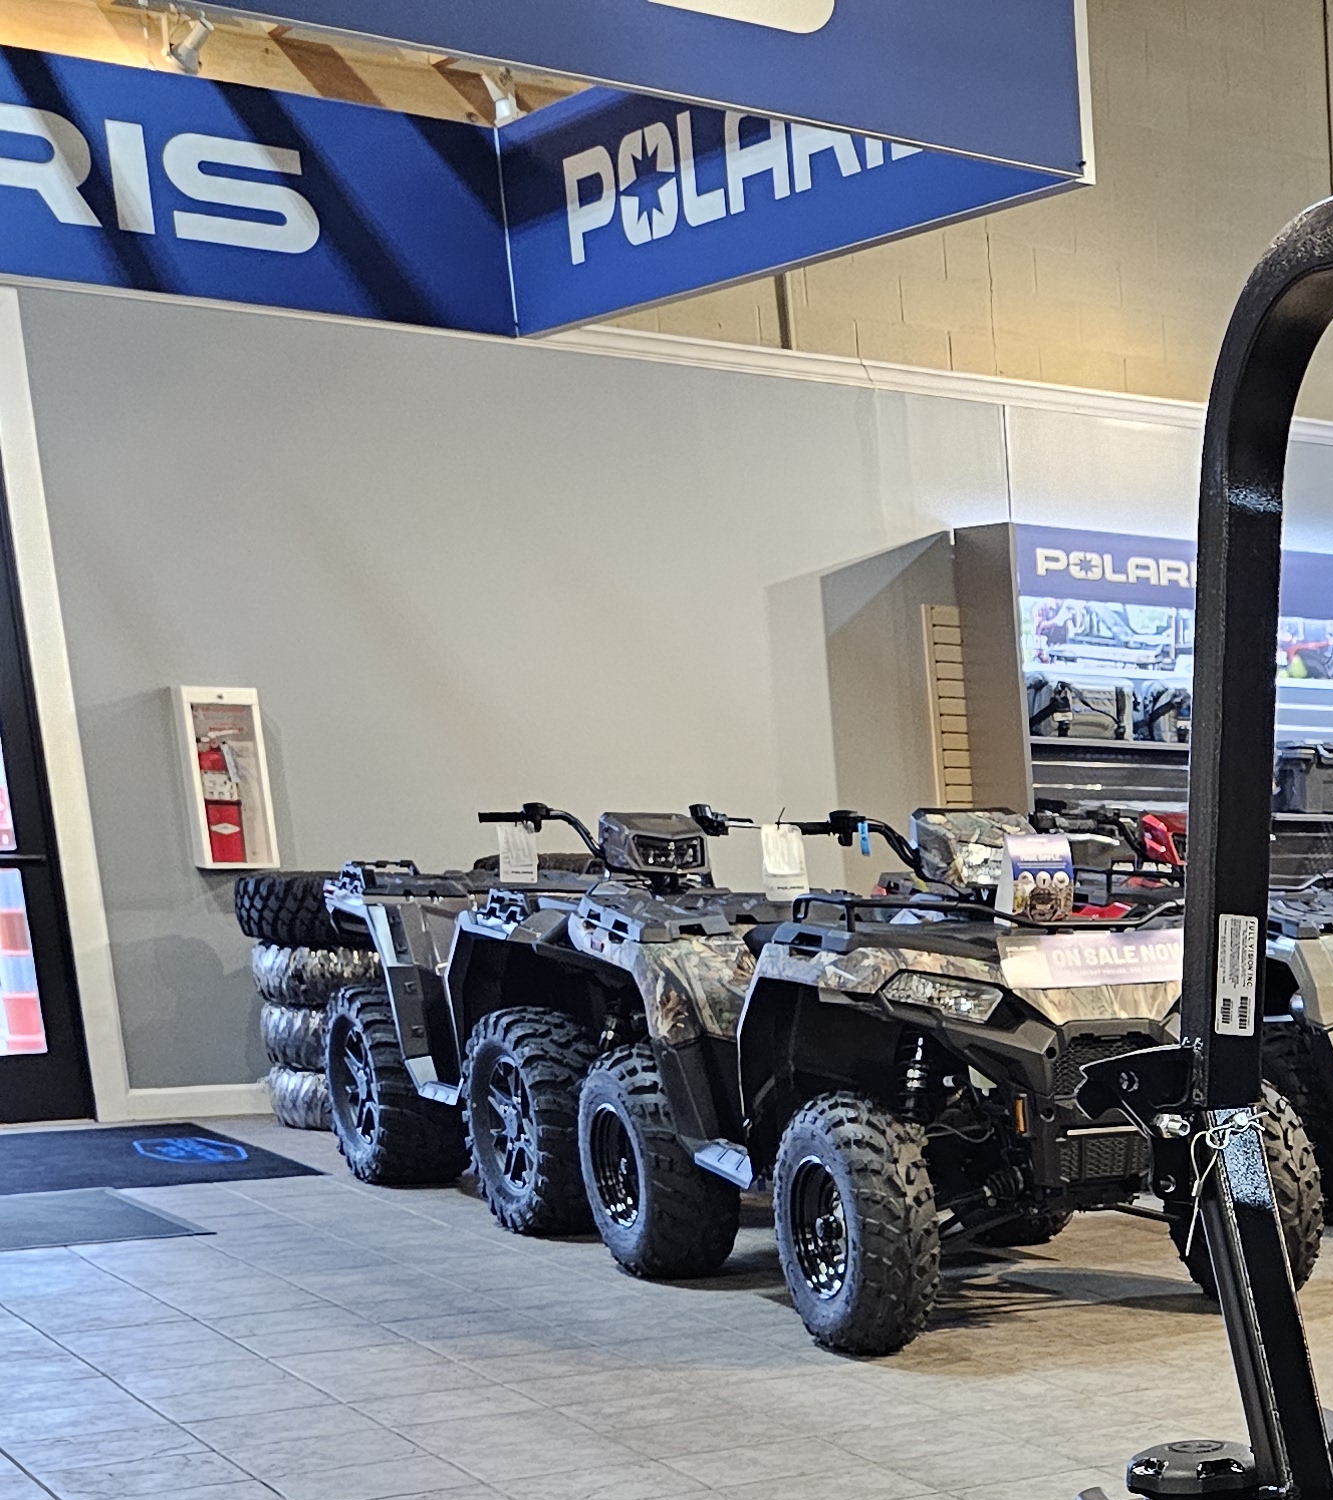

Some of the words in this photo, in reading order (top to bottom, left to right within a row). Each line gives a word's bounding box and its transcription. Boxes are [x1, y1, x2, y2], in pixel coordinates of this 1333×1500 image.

[562, 109, 924, 265] POLAR
[1035, 548, 1196, 588] POLARI
[1247, 920, 1255, 941] FULL
[1052, 948, 1082, 967] ON
[1085, 944, 1141, 966] SALE
[1246, 943, 1254, 971] VISION
